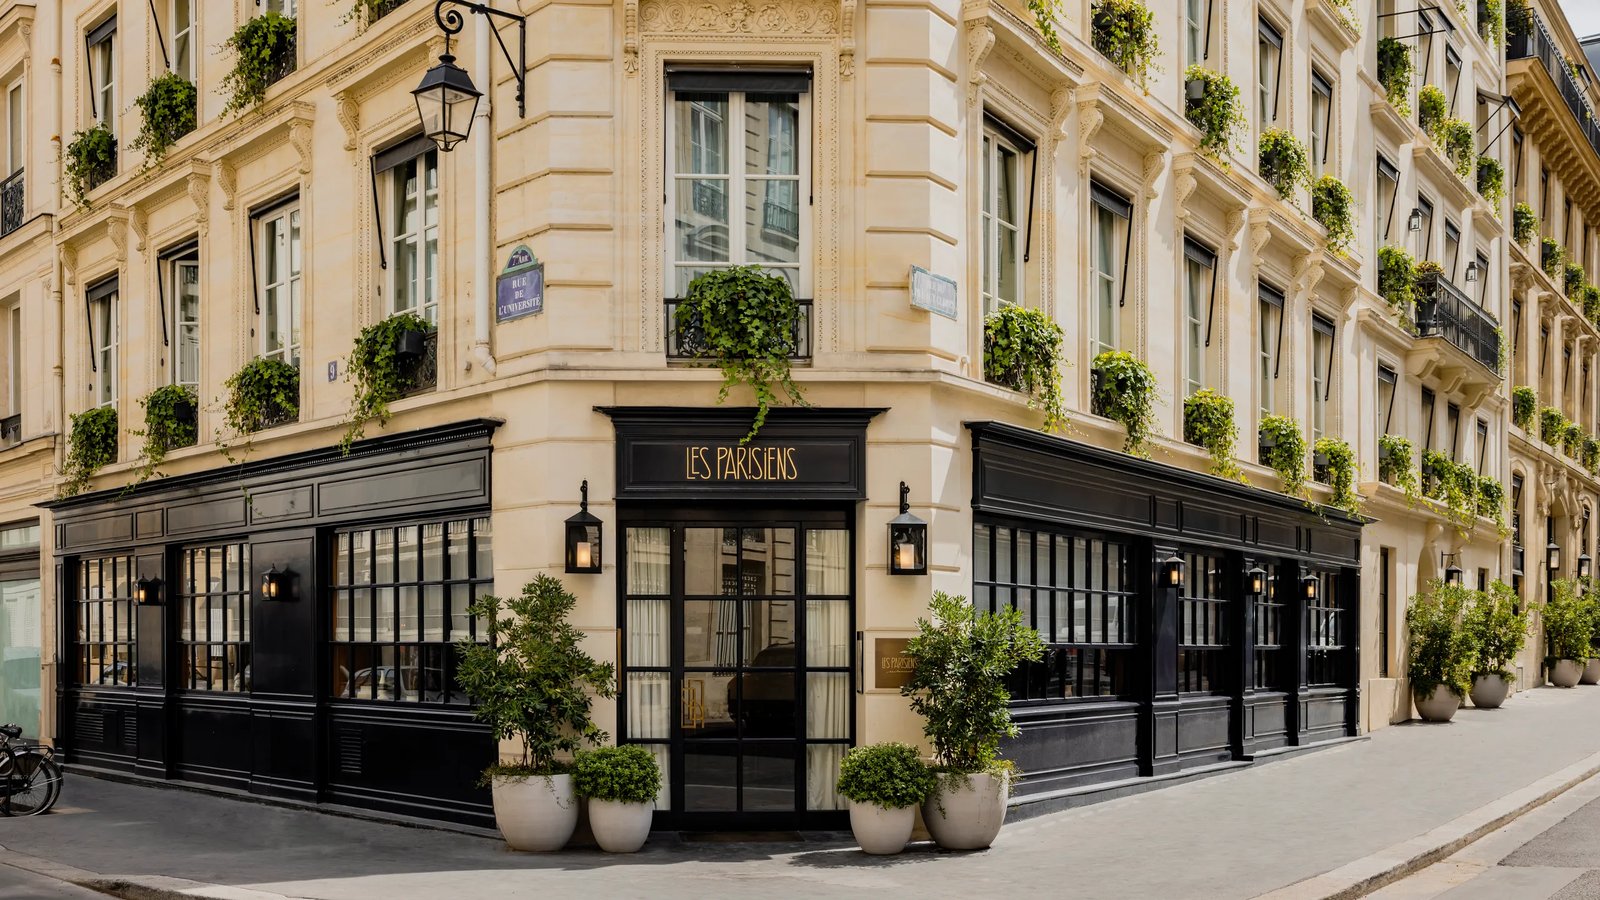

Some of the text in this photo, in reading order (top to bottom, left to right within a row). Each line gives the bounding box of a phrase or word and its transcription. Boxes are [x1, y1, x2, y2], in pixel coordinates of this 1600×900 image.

[512, 277, 527, 289] RUE
[514, 290, 524, 299] DE
[498, 294, 541, 316] L'UNIVERSITÉ
[330, 363, 335, 380] 9
[686, 446, 712, 480] LES
